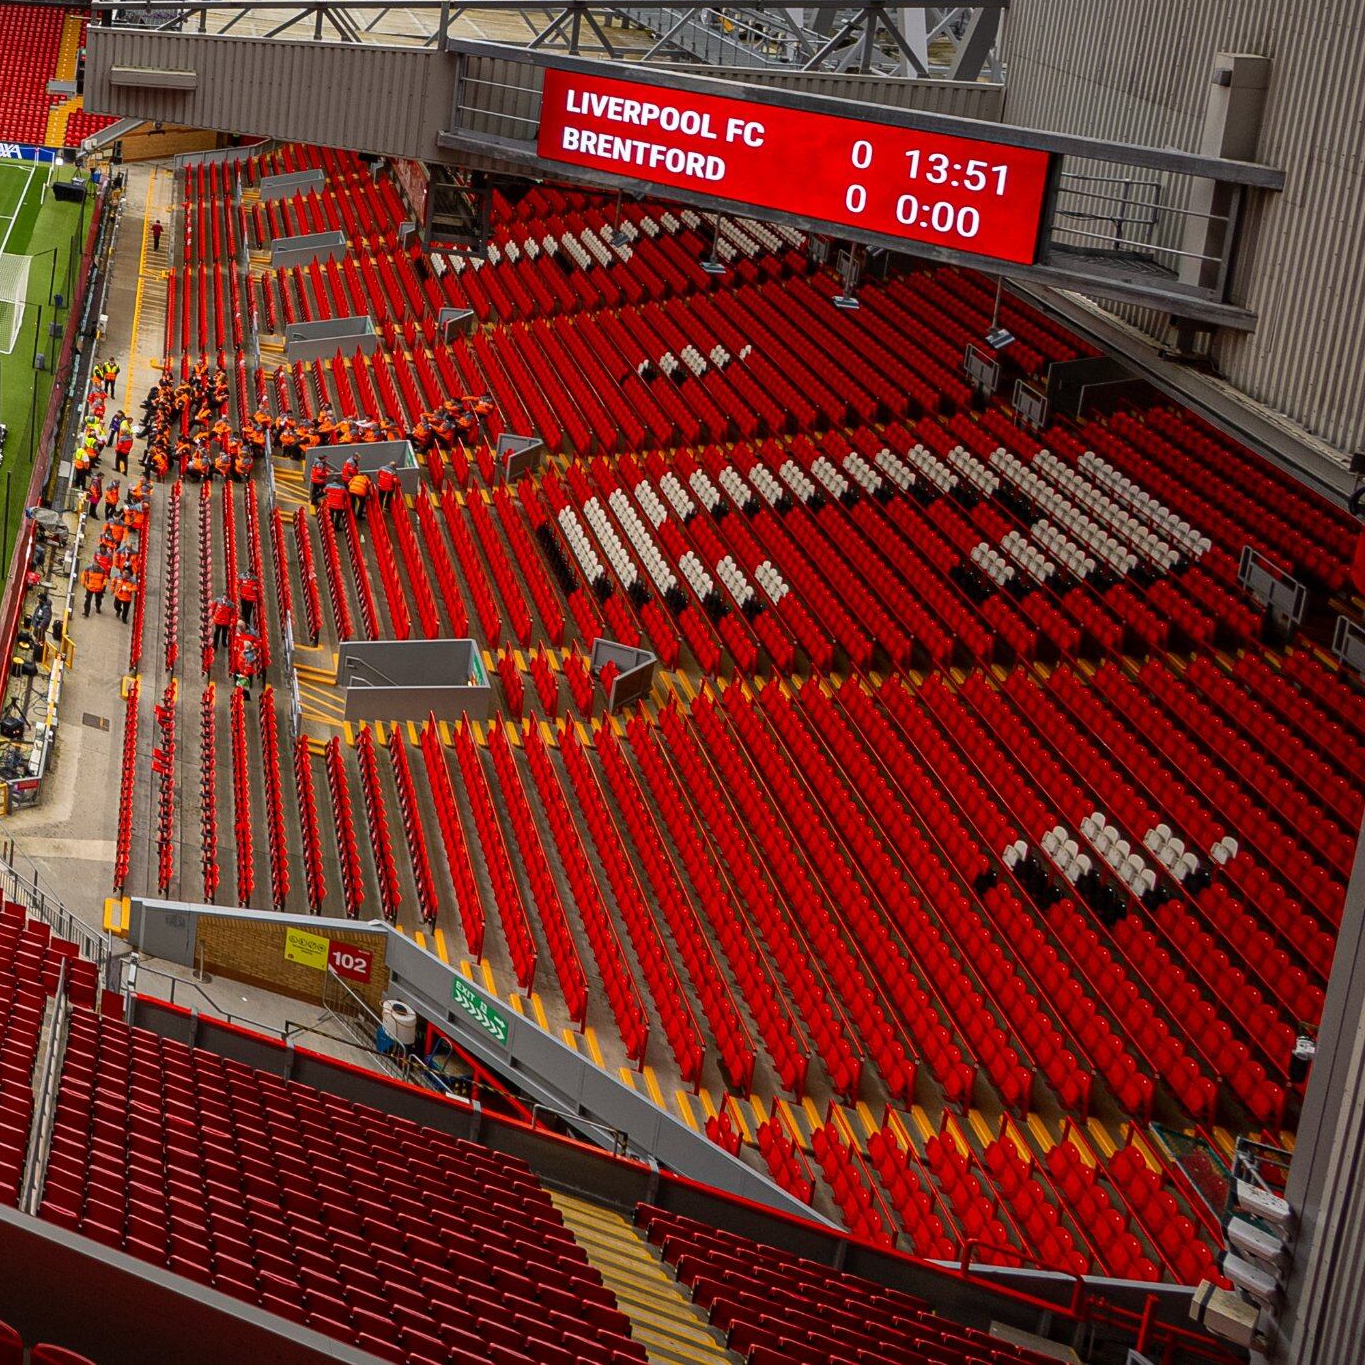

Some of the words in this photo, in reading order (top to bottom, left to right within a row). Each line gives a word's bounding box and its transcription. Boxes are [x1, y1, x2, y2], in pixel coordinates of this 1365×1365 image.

[565, 87, 719, 141] LIVERPOOL
[726, 117, 765, 148] FC
[850, 139, 873, 170] 0
[905, 149, 1010, 196] 13:51
[562, 126, 726, 182] BRENTFORD
[845, 183, 867, 214] 0
[895, 194, 981, 239] 0:00
[332, 951, 367, 974] 102
[456, 980, 476, 1002] EXIT
